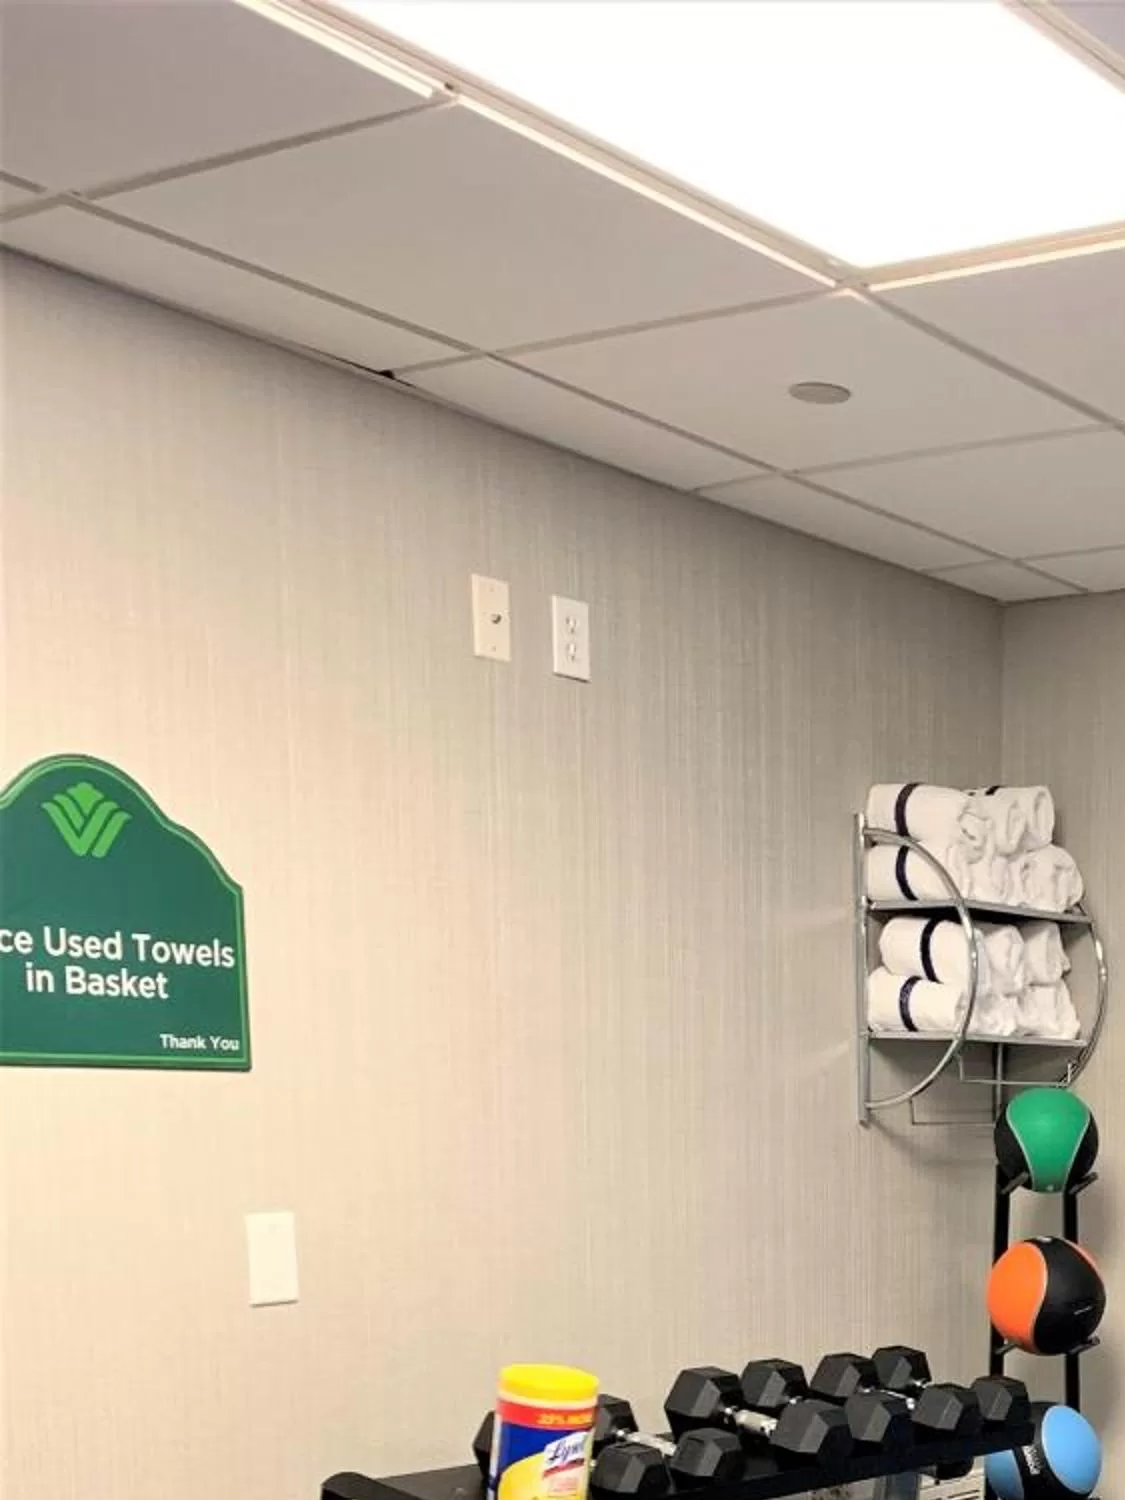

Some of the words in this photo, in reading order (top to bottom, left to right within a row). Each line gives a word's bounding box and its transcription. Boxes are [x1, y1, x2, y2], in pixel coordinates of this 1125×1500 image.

[43, 926, 123, 960] Used
[132, 934, 236, 968] Towels
[25, 961, 55, 993] in
[65, 965, 169, 999] Basket
[160, 1034, 206, 1050] Thank
[210, 1036, 240, 1051] You
